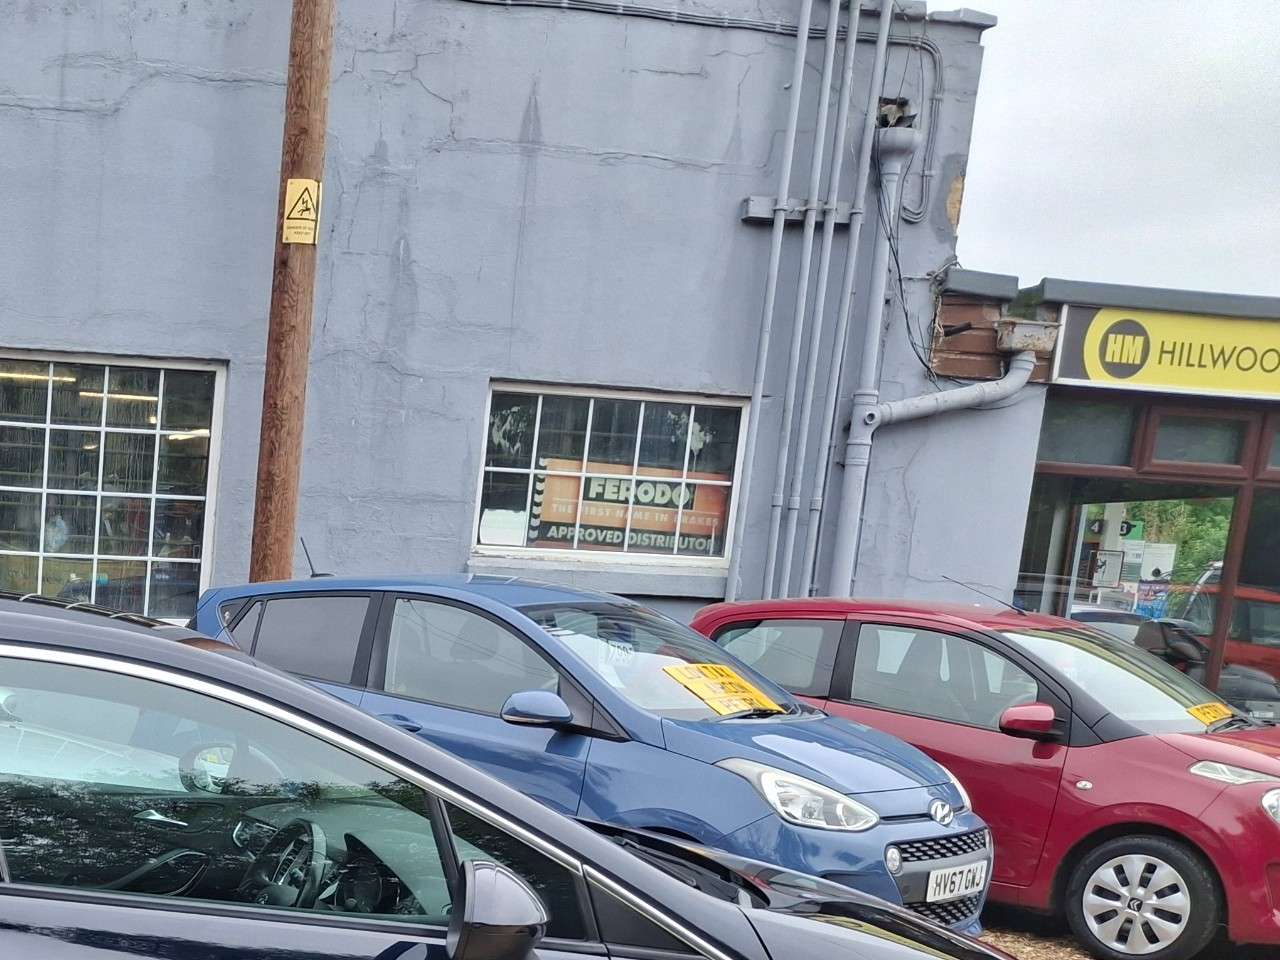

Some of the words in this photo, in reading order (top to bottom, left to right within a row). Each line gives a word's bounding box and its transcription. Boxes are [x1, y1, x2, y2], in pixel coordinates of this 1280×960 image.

[1105, 334, 1144, 364] HM
[1158, 340, 1280, 373] HILLWOO
[589, 477, 690, 506] FERODO
[578, 505, 610, 517] IRST
[615, 508, 650, 520] NME
[547, 525, 623, 544] APPROVED
[933, 871, 964, 896] HV67
